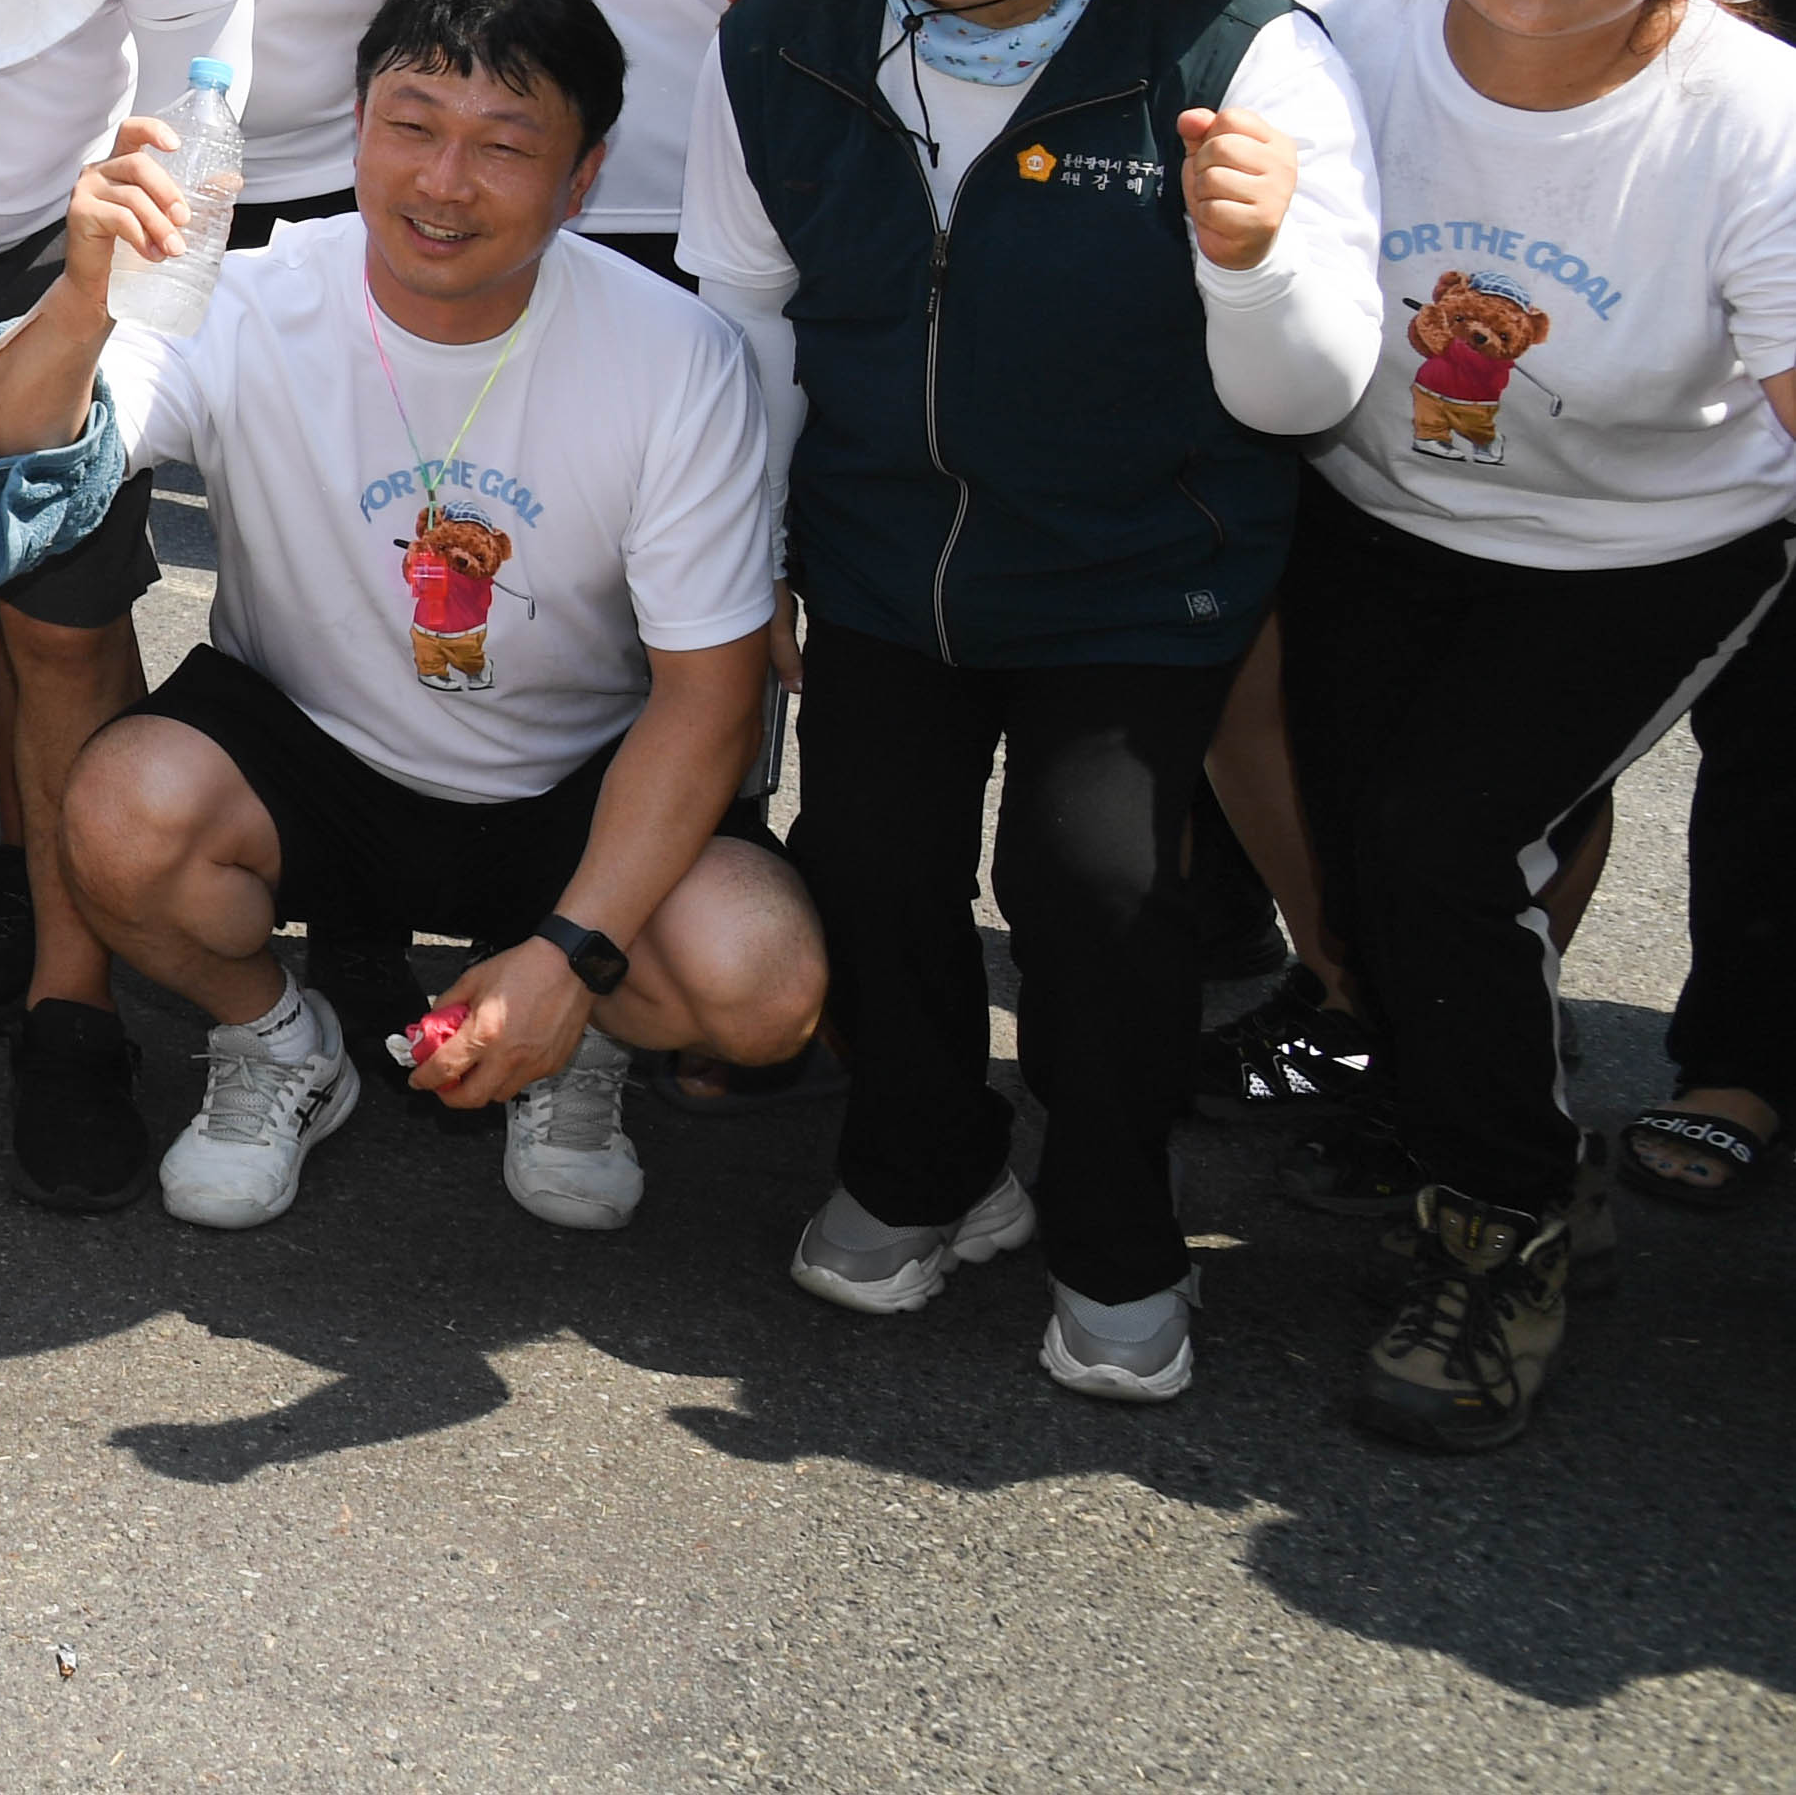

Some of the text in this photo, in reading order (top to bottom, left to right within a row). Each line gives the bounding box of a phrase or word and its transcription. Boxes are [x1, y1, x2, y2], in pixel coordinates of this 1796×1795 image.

[1381, 221, 1623, 321] OR THE GOAL
[413, 459, 477, 489] THE
[478, 468, 545, 529] GOAL
